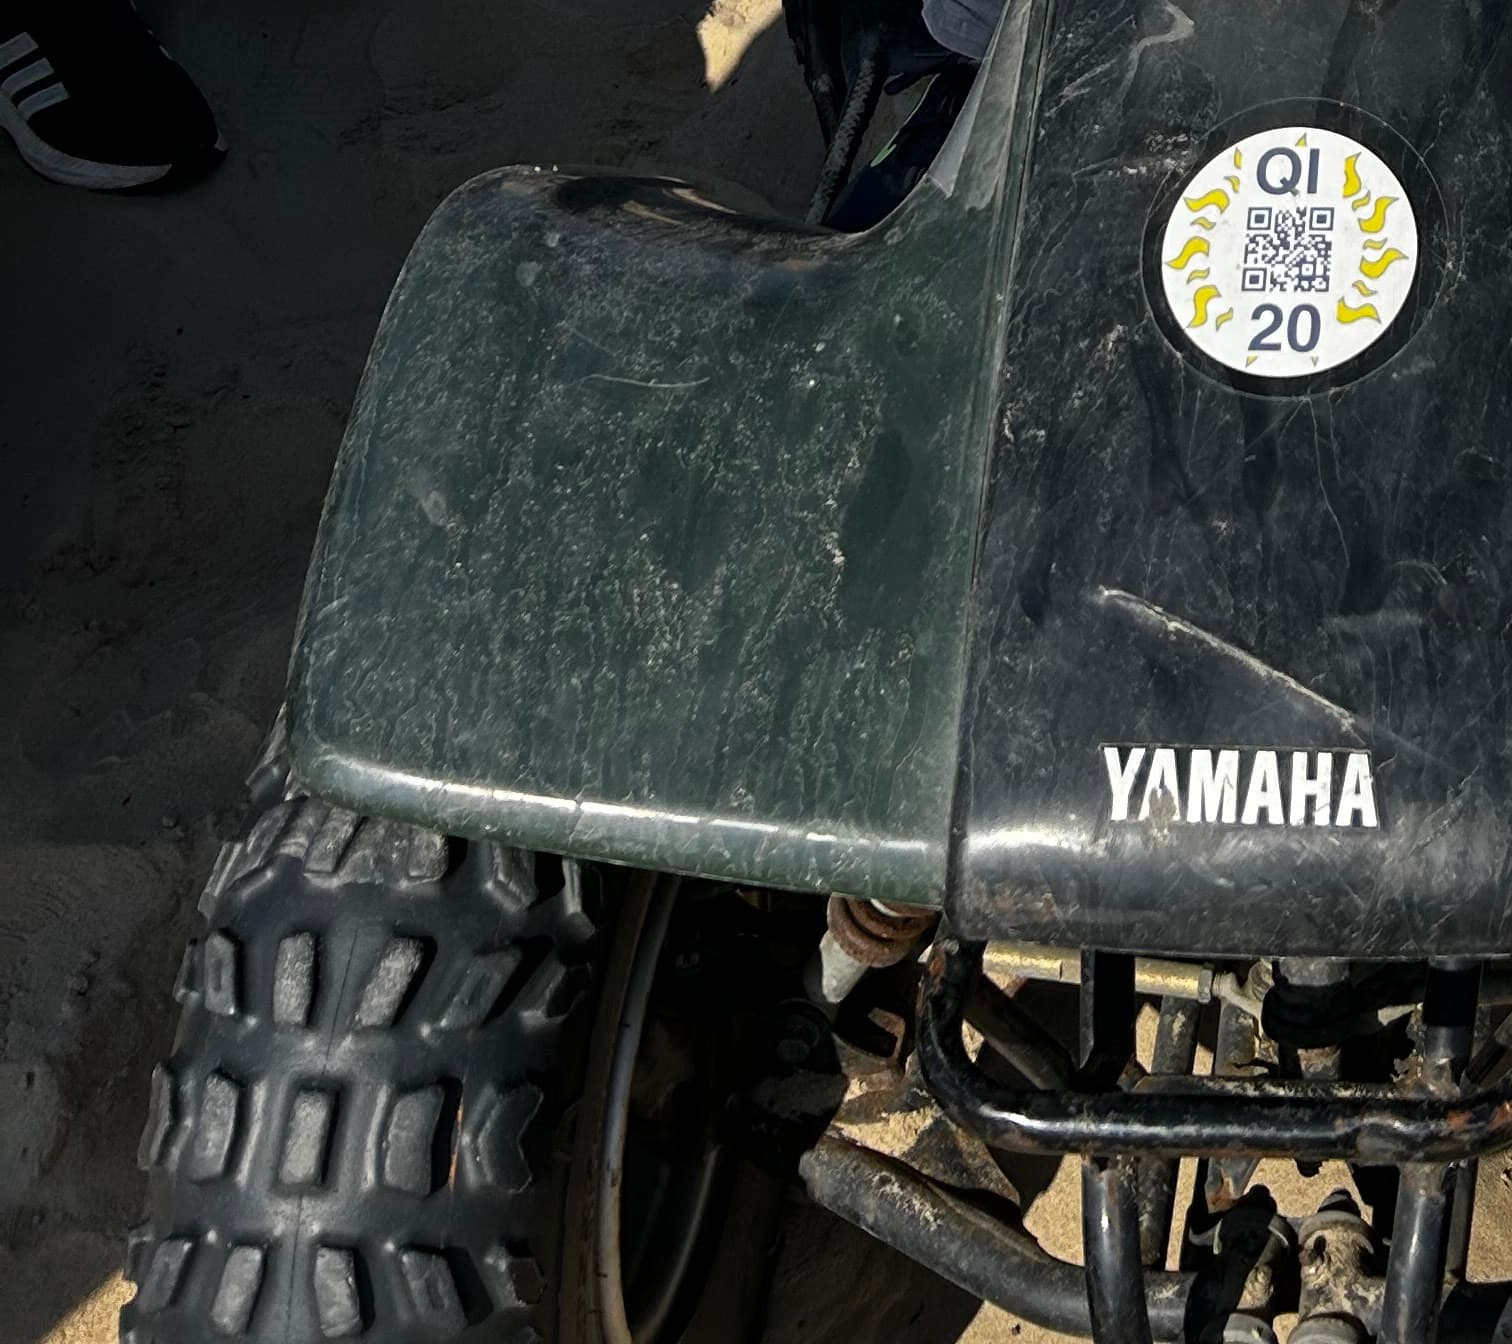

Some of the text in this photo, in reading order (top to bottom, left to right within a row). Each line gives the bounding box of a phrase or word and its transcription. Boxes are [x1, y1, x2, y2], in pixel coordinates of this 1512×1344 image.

[1256, 147, 1320, 197] QI
[1247, 303, 1321, 353] 20
[1103, 747, 1378, 828] YAMAHA
